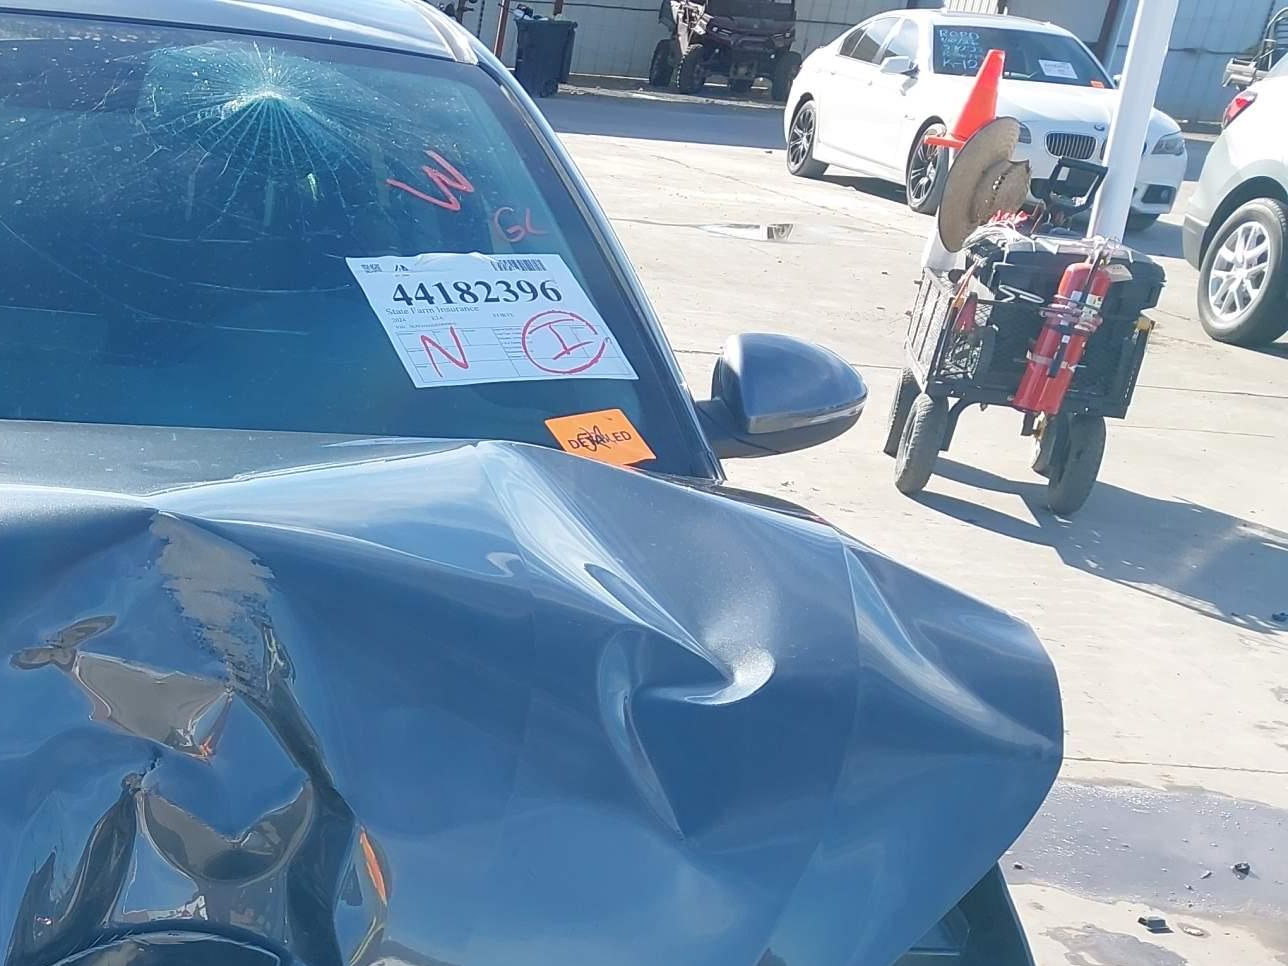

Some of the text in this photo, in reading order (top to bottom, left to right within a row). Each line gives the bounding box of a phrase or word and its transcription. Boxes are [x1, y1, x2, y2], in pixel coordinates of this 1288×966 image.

[385, 149, 475, 212] W
[392, 279, 563, 306] 44182396
[385, 305, 480, 316] State Farm Insurance
[420, 326, 469, 378] N
[567, 430, 632, 450] DETAILED
